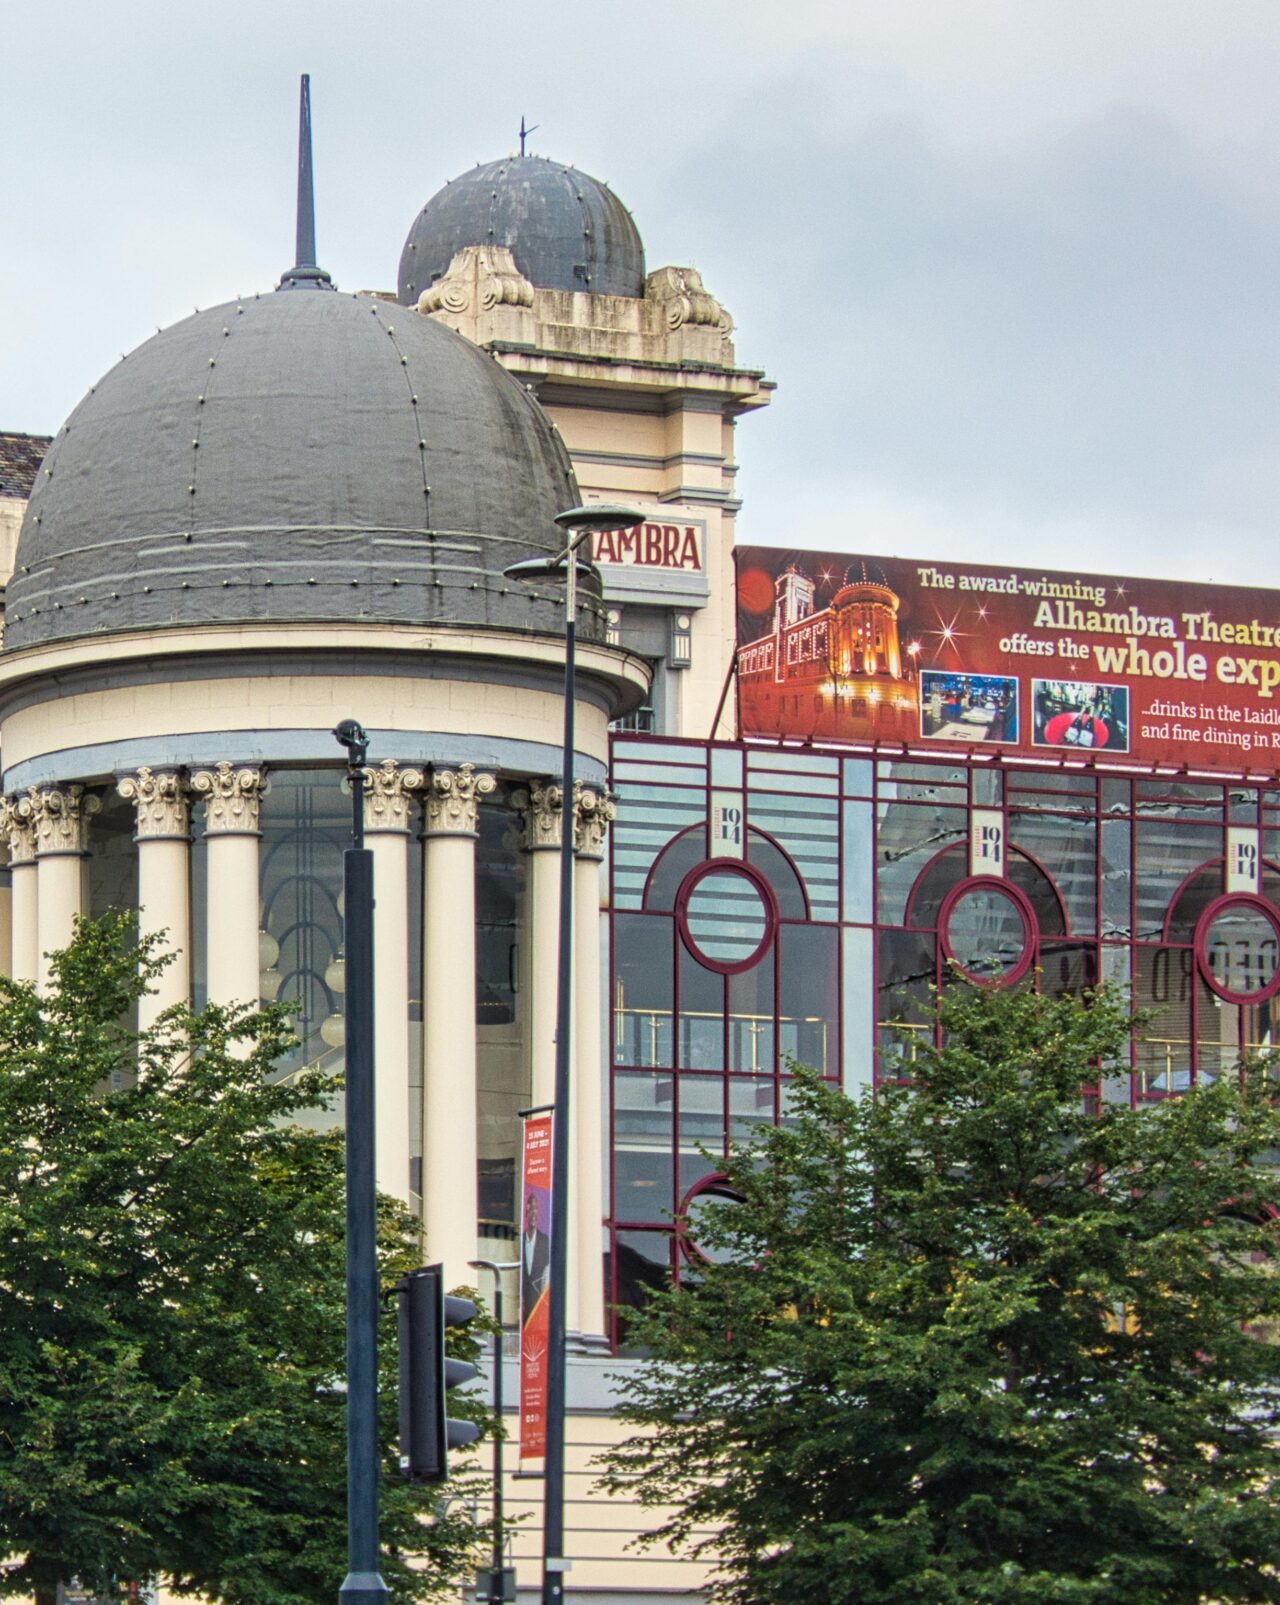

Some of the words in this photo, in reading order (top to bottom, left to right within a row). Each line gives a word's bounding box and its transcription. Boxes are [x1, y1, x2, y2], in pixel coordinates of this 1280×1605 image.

[590, 522, 702, 571] AMBRA
[917, 568, 955, 589] The
[959, 574, 1106, 607] award-winning
[1033, 600, 1178, 639] Alhambra
[999, 633, 1054, 656] offers
[1058, 637, 1090, 659] the
[1093, 637, 1208, 681] whole
[1200, 703, 1215, 720] in
[1217, 704, 1241, 722] the
[1141, 723, 1170, 740] and
[1172, 724, 1201, 742] fine
[1203, 726, 1251, 751] dining
[1253, 731, 1269, 747] in
[722, 807, 741, 827] 19
[722, 825, 741, 845] 14
[982, 826, 1001, 845] 19
[982, 843, 1000, 863] 14
[1238, 843, 1256, 862] 19
[1238, 860, 1256, 879] 14
